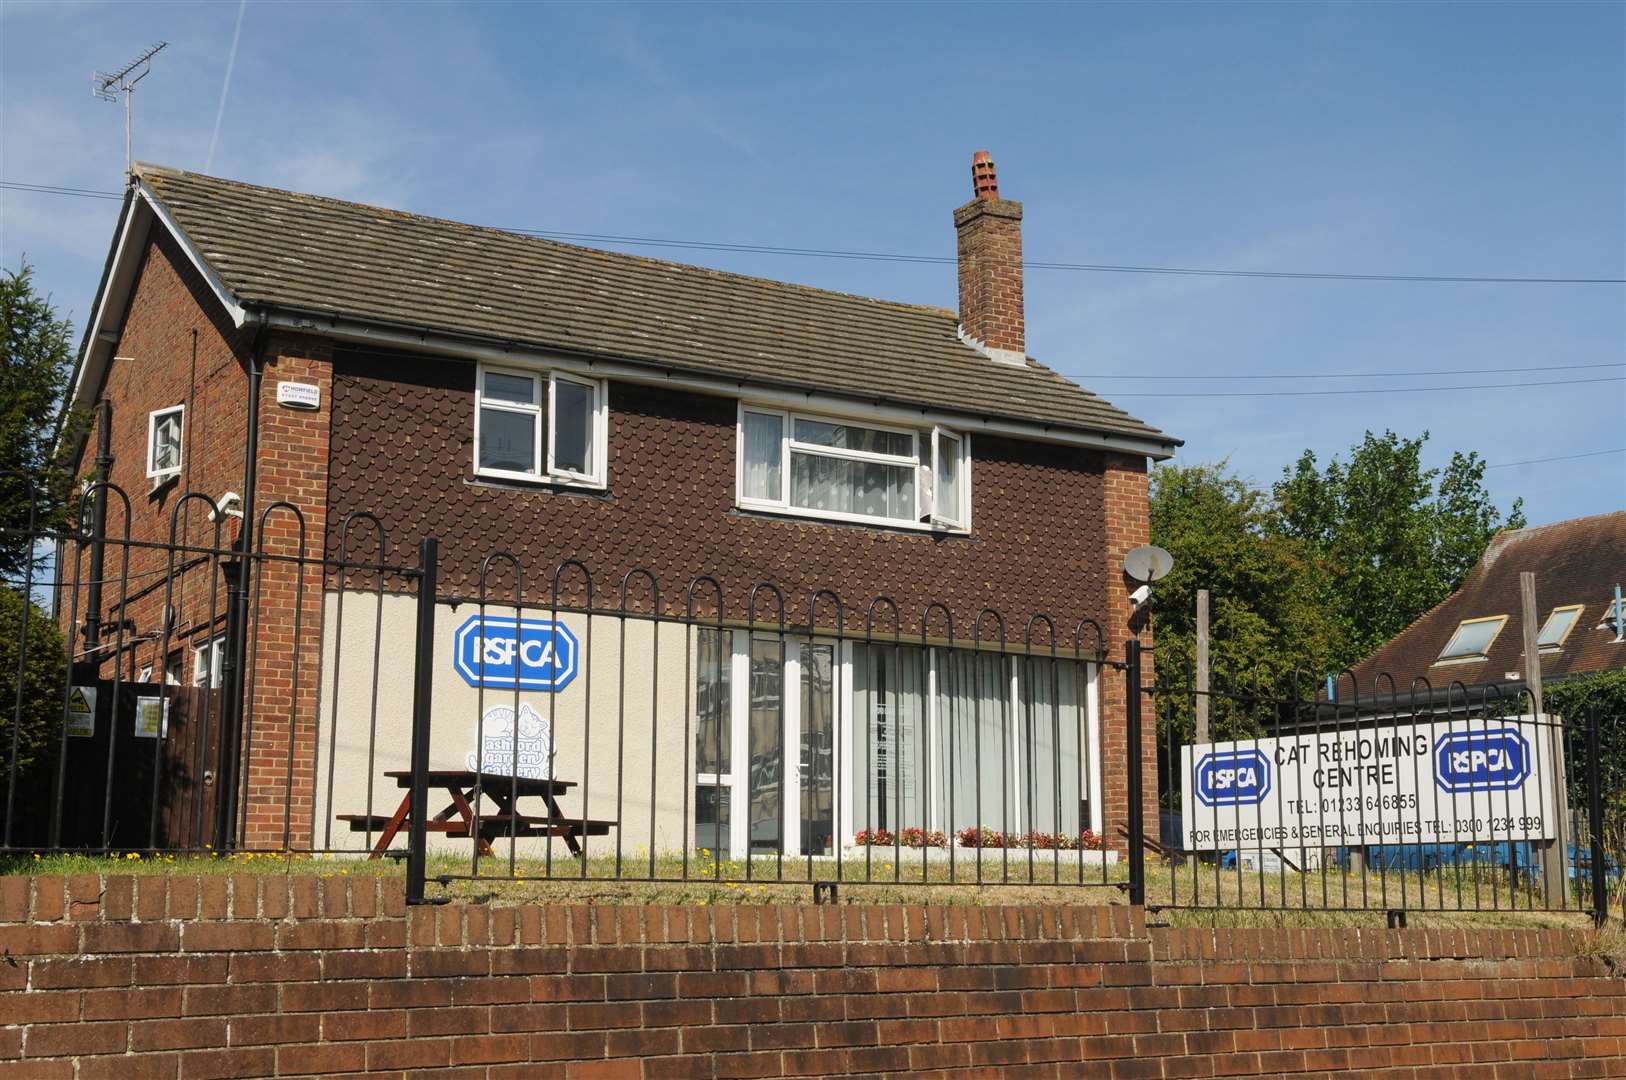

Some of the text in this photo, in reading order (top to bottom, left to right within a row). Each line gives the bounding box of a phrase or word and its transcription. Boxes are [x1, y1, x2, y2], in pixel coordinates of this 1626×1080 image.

[472, 636, 563, 669] RSPCA
[485, 738, 542, 752] ashord
[1274, 734, 1428, 767] CAT REHOMING
[485, 751, 543, 765] garen
[1448, 748, 1514, 773] RSPCA
[1207, 767, 1258, 790] RSPCA
[1287, 799, 1318, 815] TEL:
[1366, 793, 1416, 811] 646855
[1189, 829, 1211, 843] FOR
[1291, 825, 1299, 839] &
[1301, 823, 1355, 838] GENERAL
[1424, 819, 1452, 834] TEL:
[1455, 818, 1483, 833] 0300
[1518, 815, 1542, 831] 999
